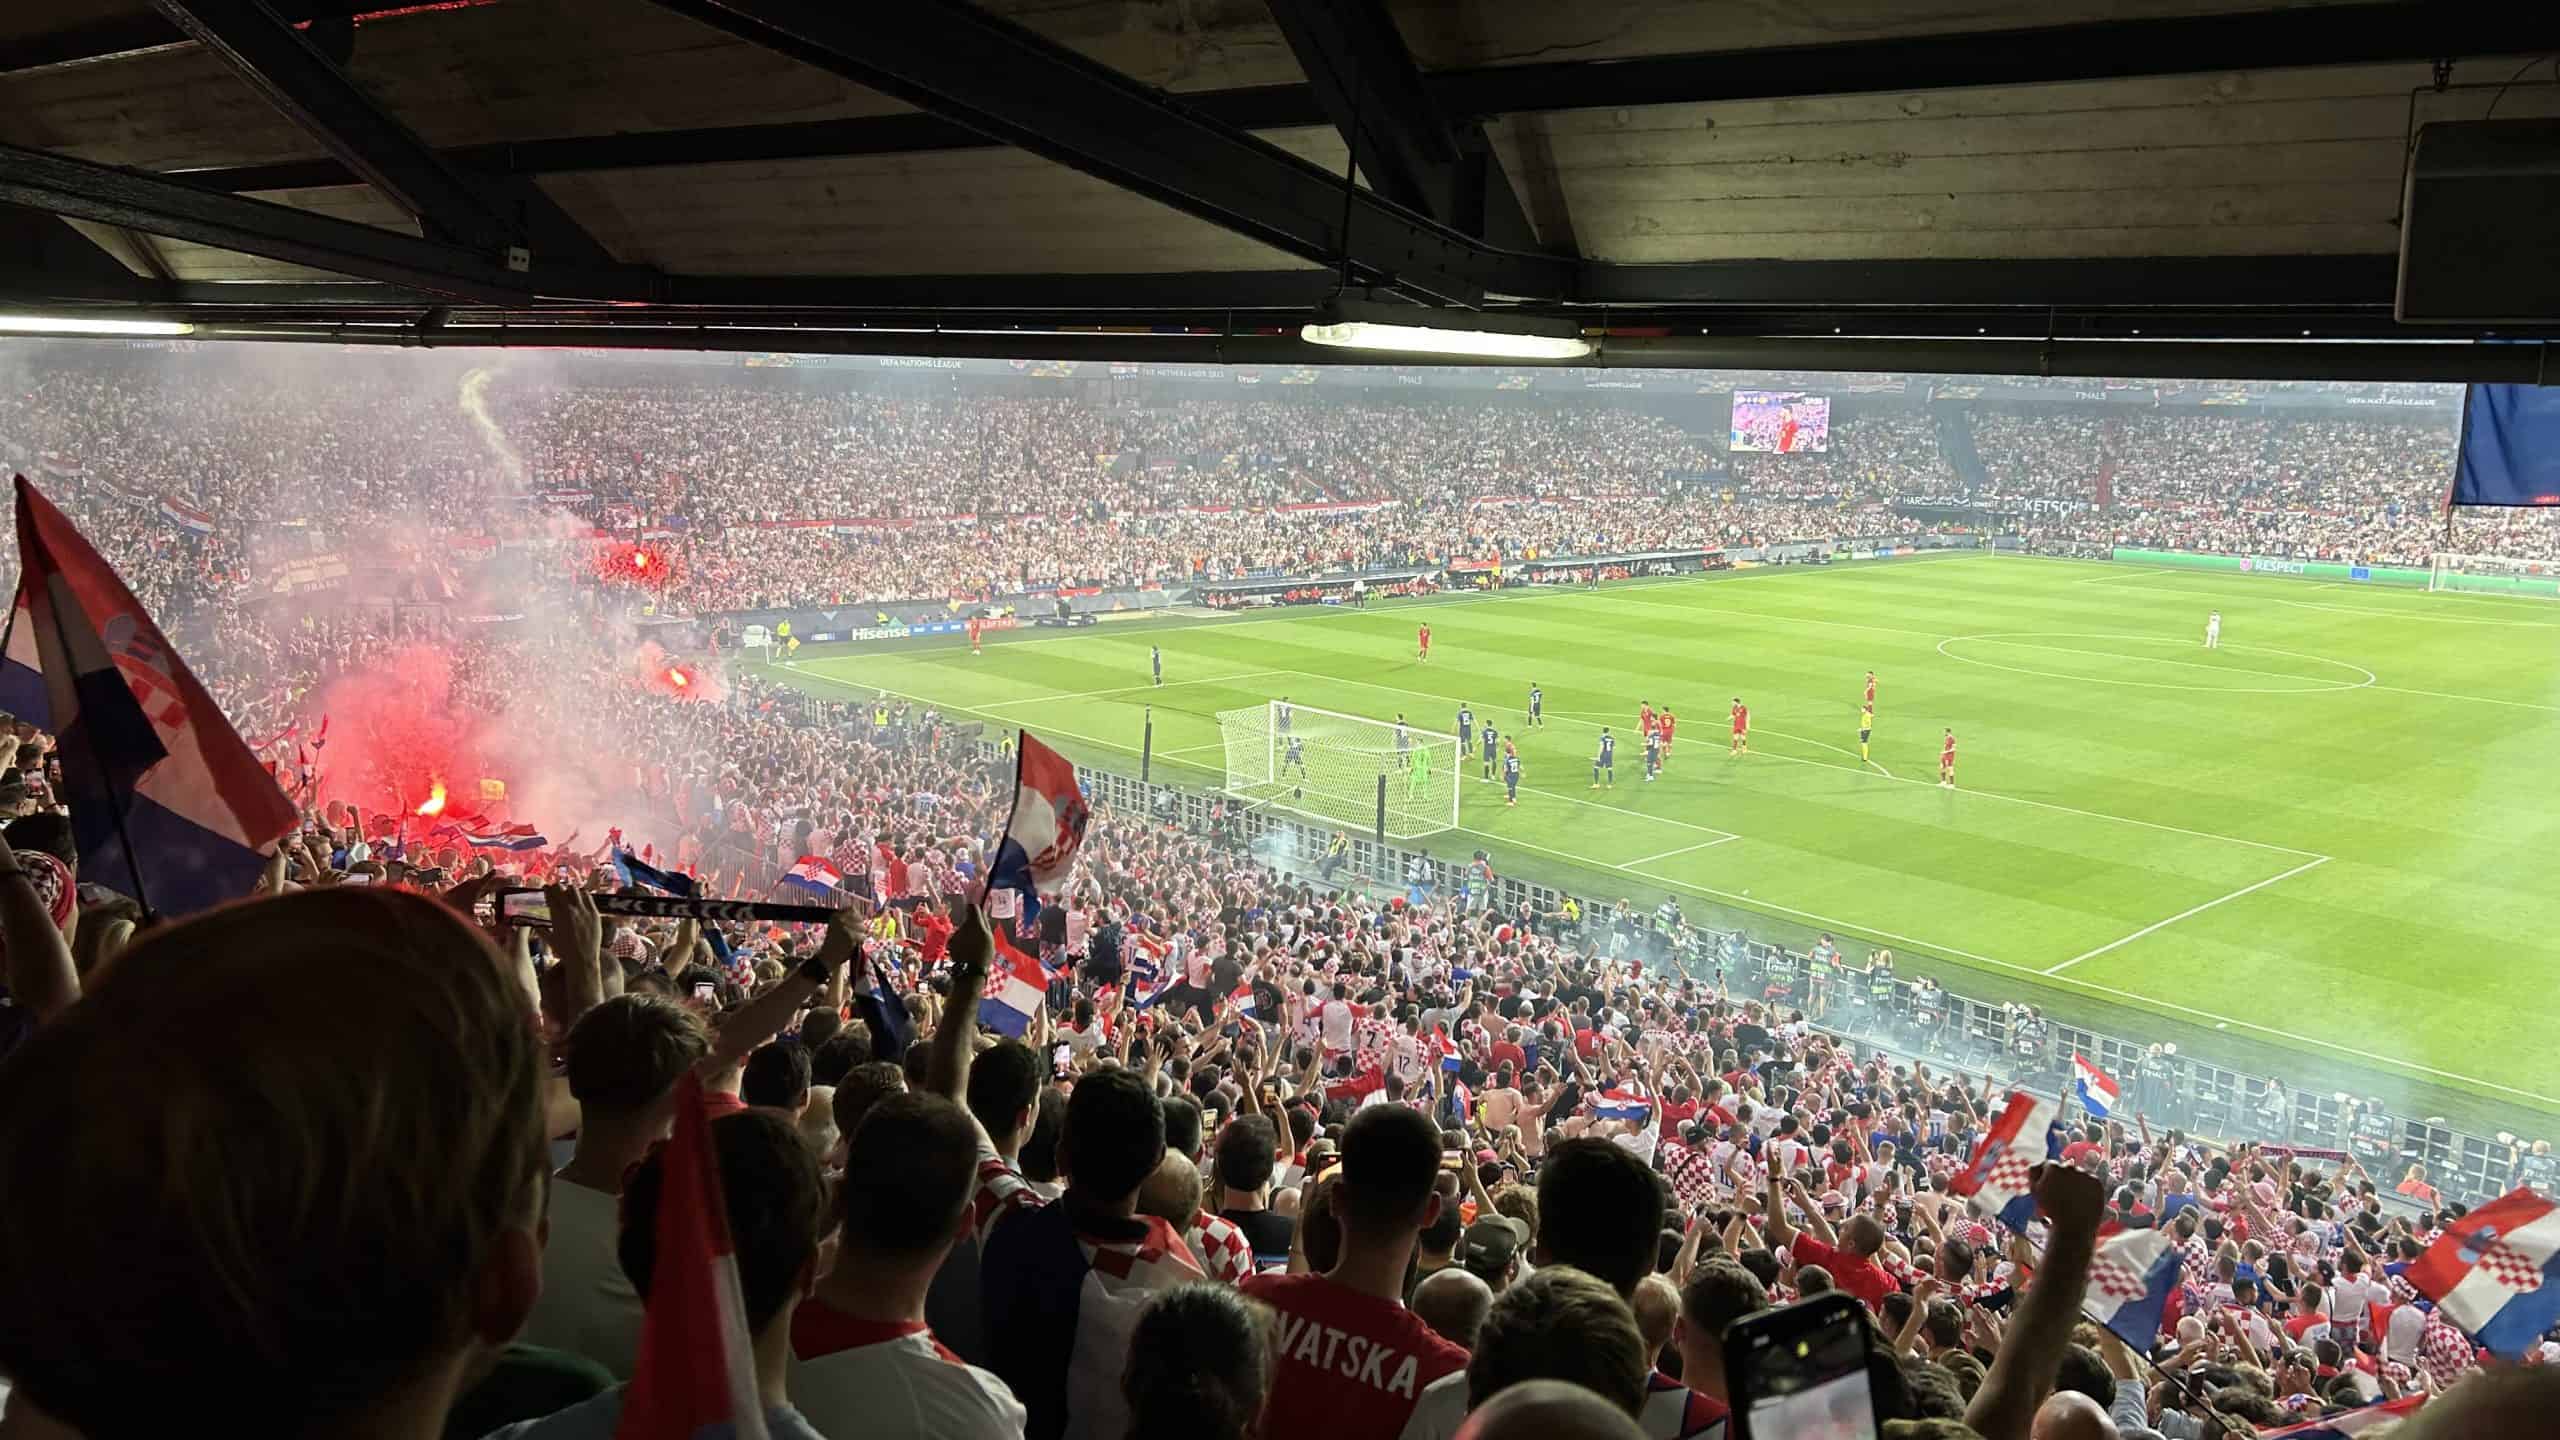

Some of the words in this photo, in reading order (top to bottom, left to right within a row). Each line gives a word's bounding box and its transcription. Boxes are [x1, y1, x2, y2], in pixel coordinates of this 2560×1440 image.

[2024, 499, 2079, 513] KETSCH
[2255, 561, 2305, 575] RESPECT
[852, 625, 911, 641] Hisense
[1366, 1030, 1376, 1048] 7
